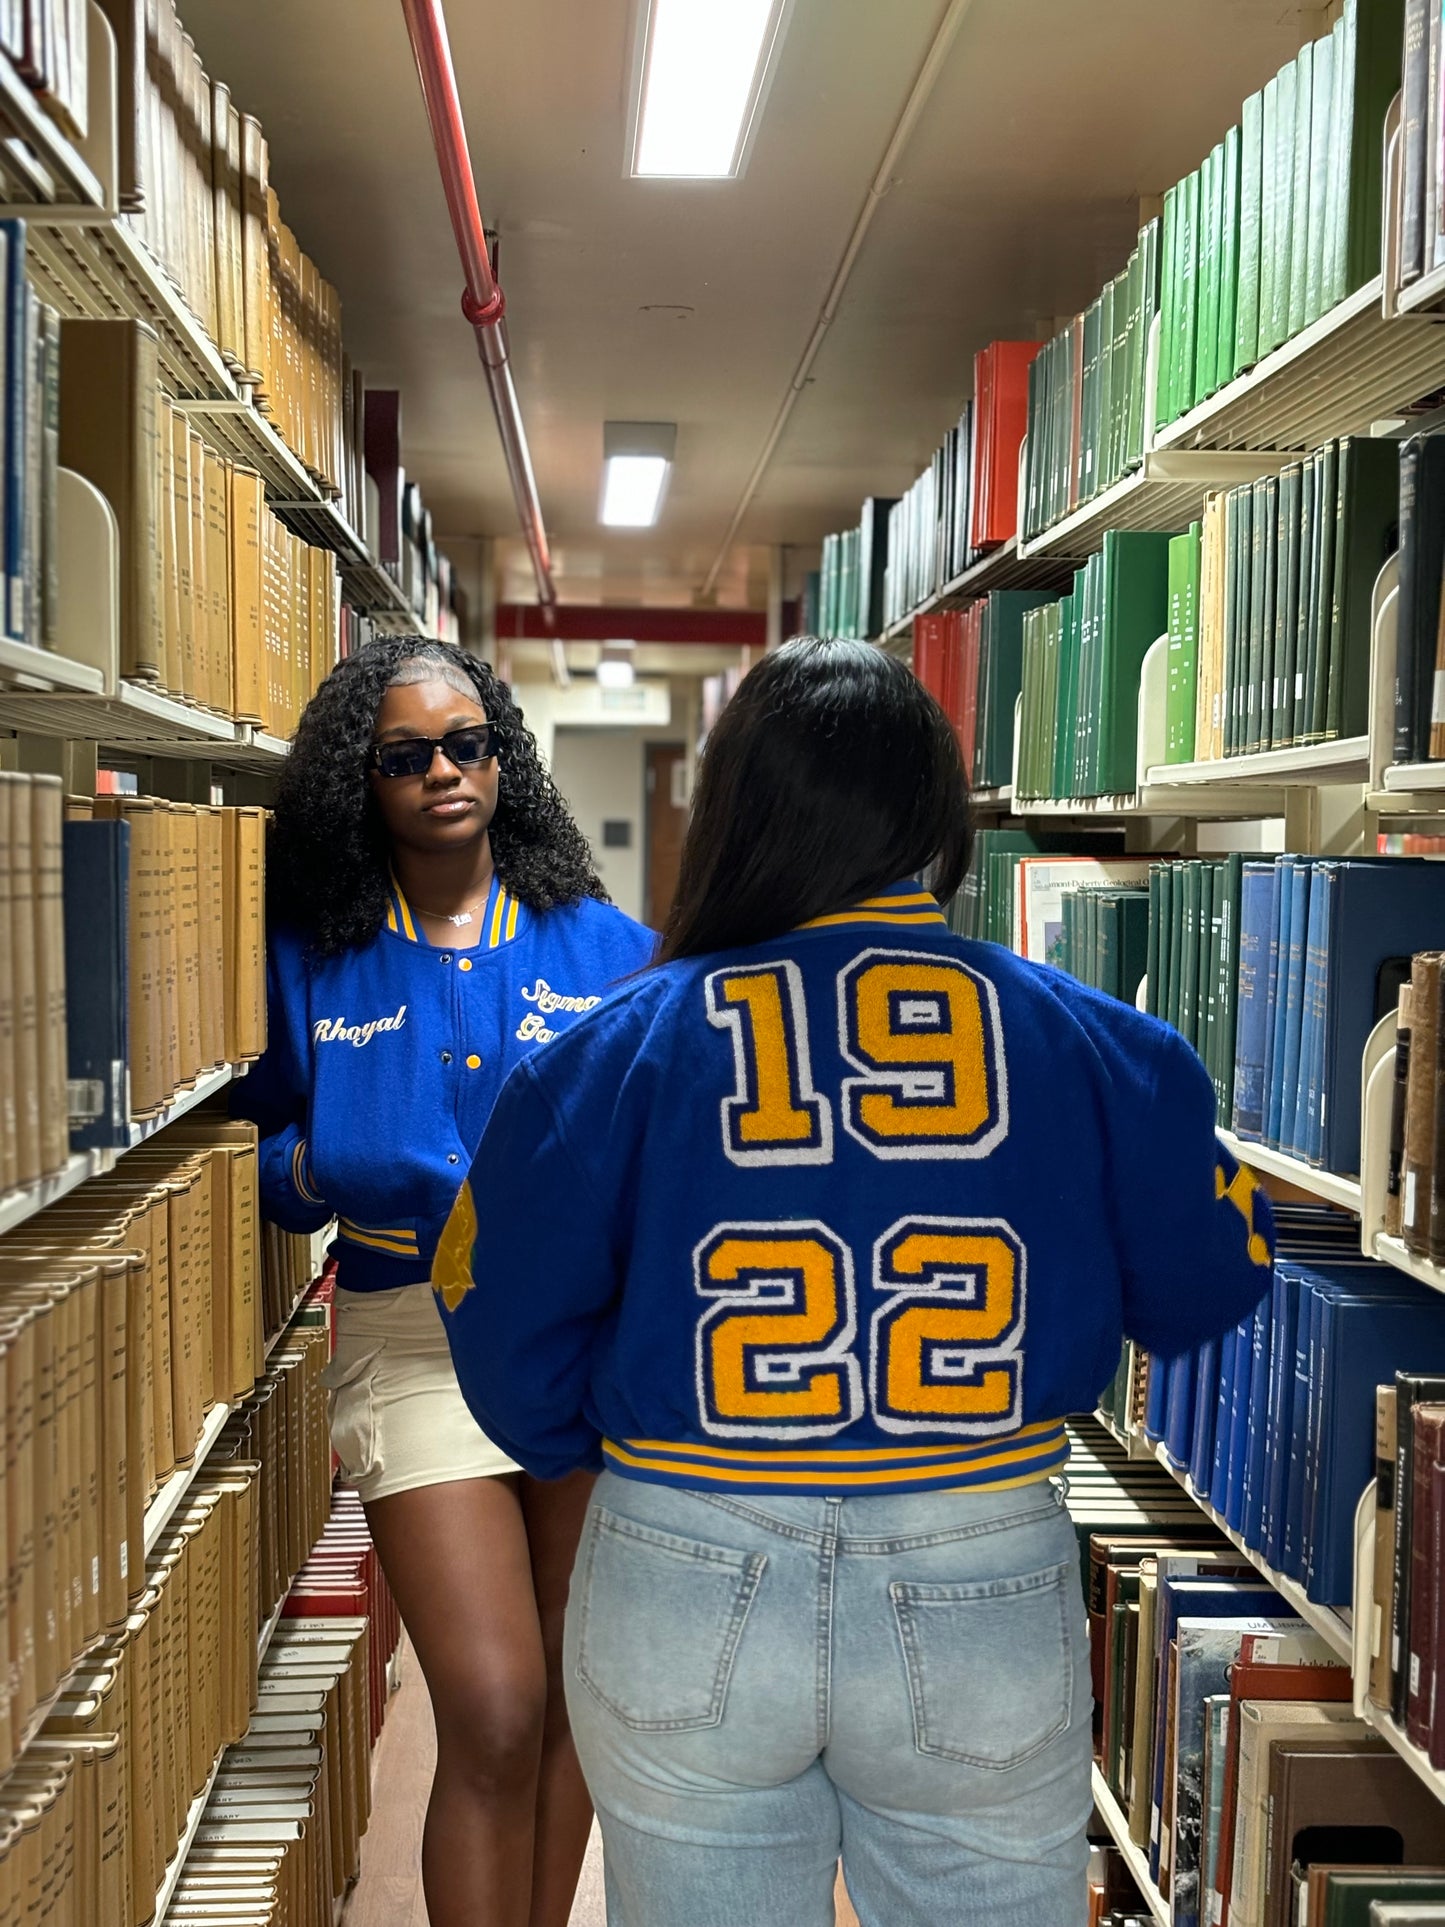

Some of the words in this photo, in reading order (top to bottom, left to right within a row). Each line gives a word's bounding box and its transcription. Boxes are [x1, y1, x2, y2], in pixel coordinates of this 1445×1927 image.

[313, 1005, 407, 1050] Rhoyal
[516, 1012, 560, 1043] Ga
[521, 978, 603, 1014] Sigma
[705, 947, 1009, 1167] 19
[692, 1213, 1027, 1441] 22
[1395, 1446, 1405, 1549] Principles
